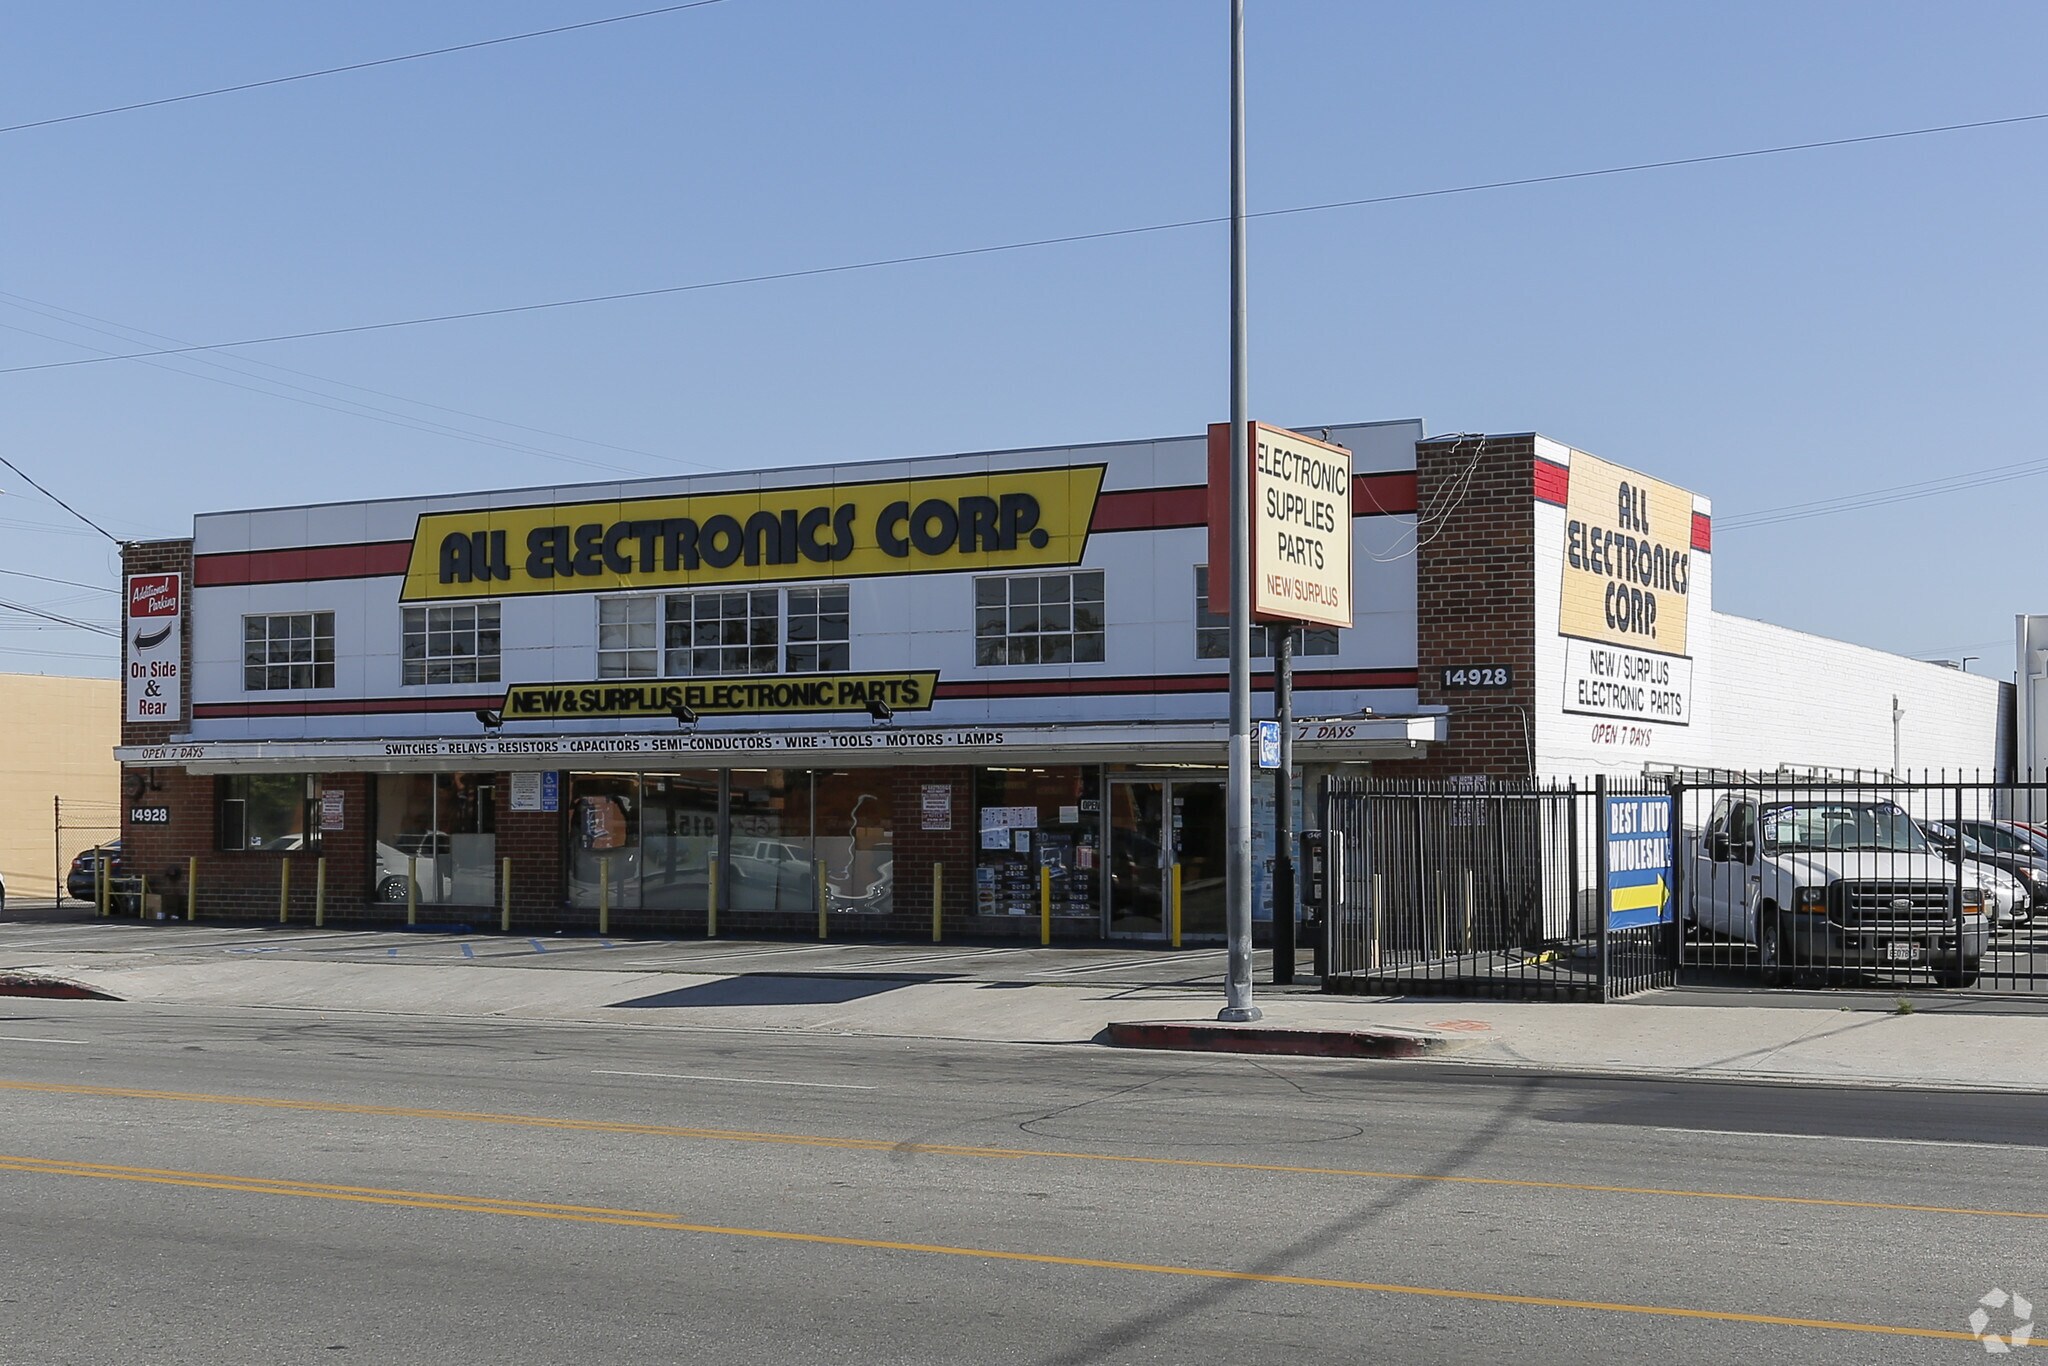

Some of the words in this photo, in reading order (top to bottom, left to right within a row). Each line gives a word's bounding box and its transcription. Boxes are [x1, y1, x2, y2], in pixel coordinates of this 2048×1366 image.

[1258, 442, 1346, 497] ELECTRONIC
[1266, 487, 1335, 534] SUPPLIES
[1618, 481, 1649, 536] ALL
[439, 529, 511, 584] ALL
[525, 502, 855, 580] ELECTRONICS
[874, 492, 1049, 559] CORP.
[1278, 531, 1325, 571] PARTS
[1568, 519, 1688, 596] ELECTRONICS
[132, 576, 169, 604] Additional
[148, 596, 176, 613] Parking
[1605, 580, 1657, 640] CORP.
[131, 661, 146, 678] On
[150, 660, 177, 677] Side
[1445, 668, 1507, 686] 14928
[144, 679, 162, 697] &
[685, 681, 834, 709] ELECTRONIC
[837, 678, 919, 706] PARTS
[1578, 678, 1645, 712] ELECTRONIC
[1650, 689, 1682, 716] PARTS
[139, 699, 167, 715] Rear
[385, 743, 438, 755] SWITCHES
[448, 742, 487, 754] RELAYS
[498, 741, 559, 753] RESISTORS
[570, 739, 640, 752] CAPACITORS
[784, 736, 818, 748] WIRE
[831, 735, 873, 747] TOOLS
[886, 733, 943, 746] MOTORS
[956, 733, 1004, 745] LAMPS
[1299, 727, 1309, 740] 7
[1316, 725, 1356, 739] DAYS
[1591, 723, 1618, 744] OPEN
[1621, 726, 1628, 745] 7
[1629, 727, 1652, 747] DAYS
[142, 747, 167, 759] OPEN
[171, 748, 177, 758] 7
[180, 747, 204, 758] DAYS
[131, 808, 168, 822] 14928
[1611, 802, 1638, 834] BEST
[1640, 801, 1669, 833] AUTO
